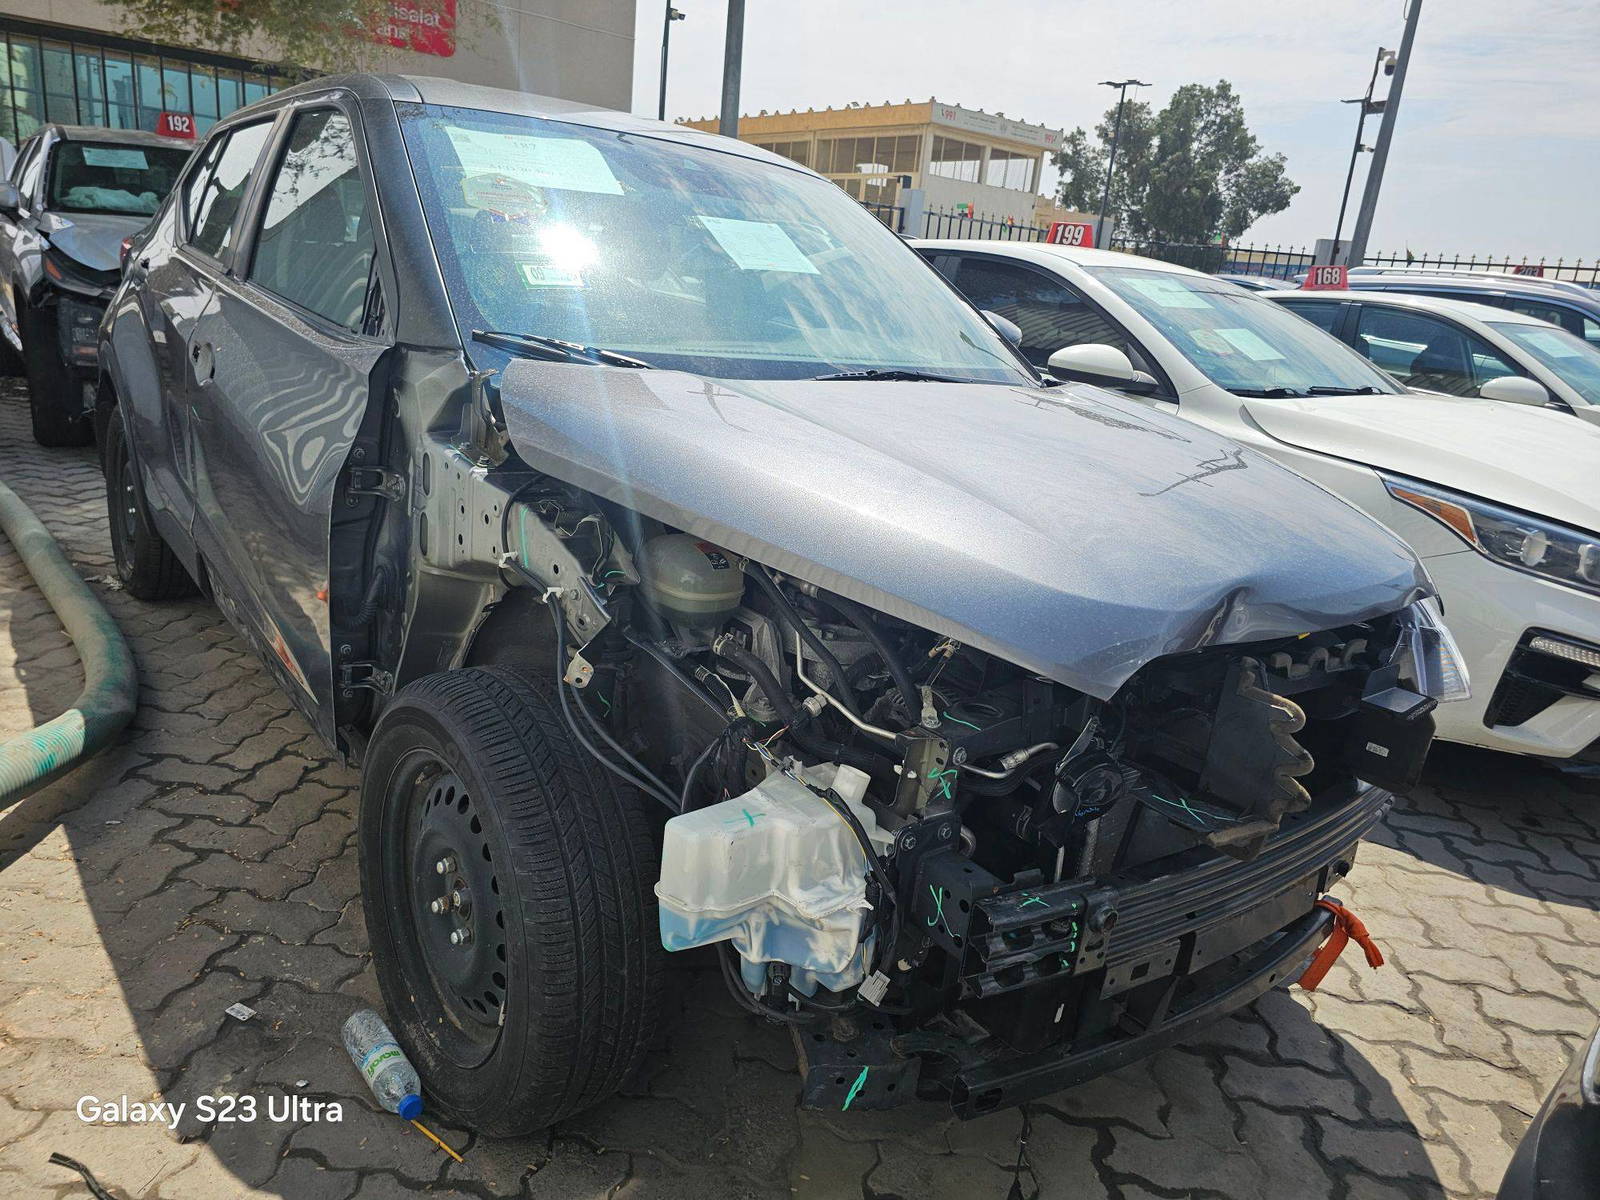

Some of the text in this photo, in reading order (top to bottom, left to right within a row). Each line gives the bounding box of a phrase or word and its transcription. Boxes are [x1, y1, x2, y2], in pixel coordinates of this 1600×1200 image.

[167, 115, 191, 133] 192
[1055, 224, 1085, 246] 199
[1317, 267, 1341, 285] 168
